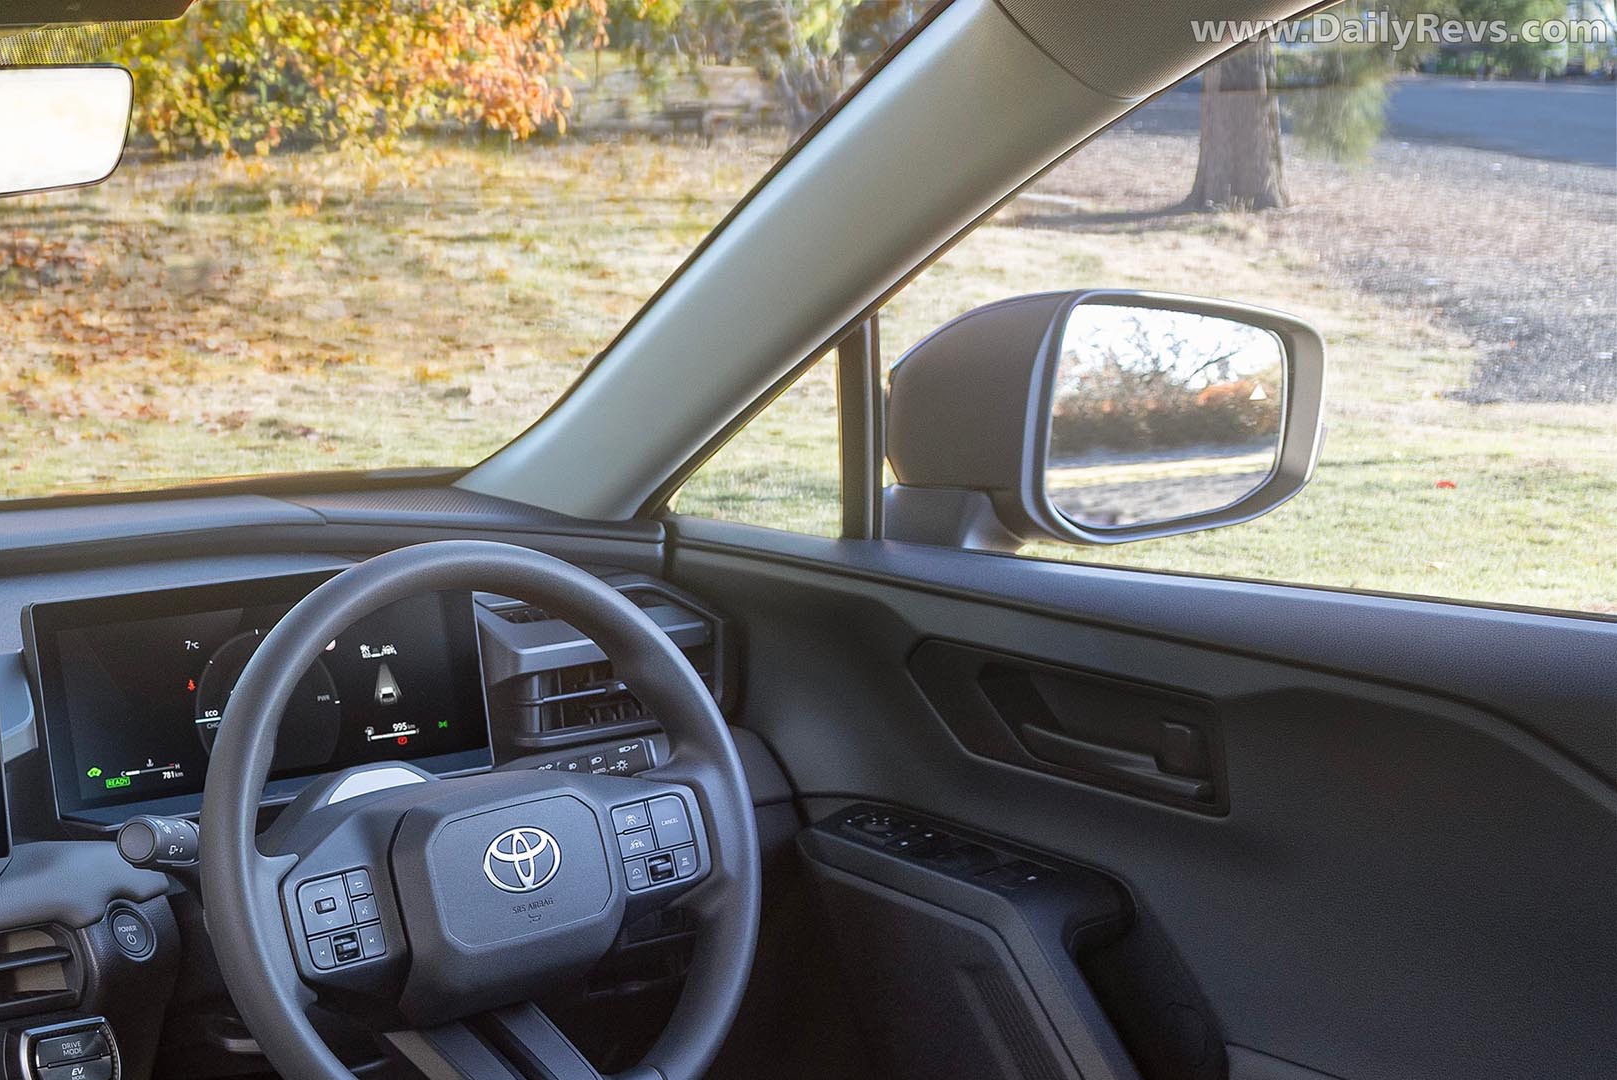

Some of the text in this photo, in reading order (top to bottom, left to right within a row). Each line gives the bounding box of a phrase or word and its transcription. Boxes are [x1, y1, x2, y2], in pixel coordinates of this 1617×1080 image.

[204, 709, 219, 718] ECO
[107, 779, 129, 788] READY
[512, 897, 554, 914] SRS AIRBAG
[117, 925, 137, 933] POWER
[62, 1041, 82, 1050] DRIVE
[63, 1047, 83, 1056] MODE
[71, 1067, 84, 1076] EV
